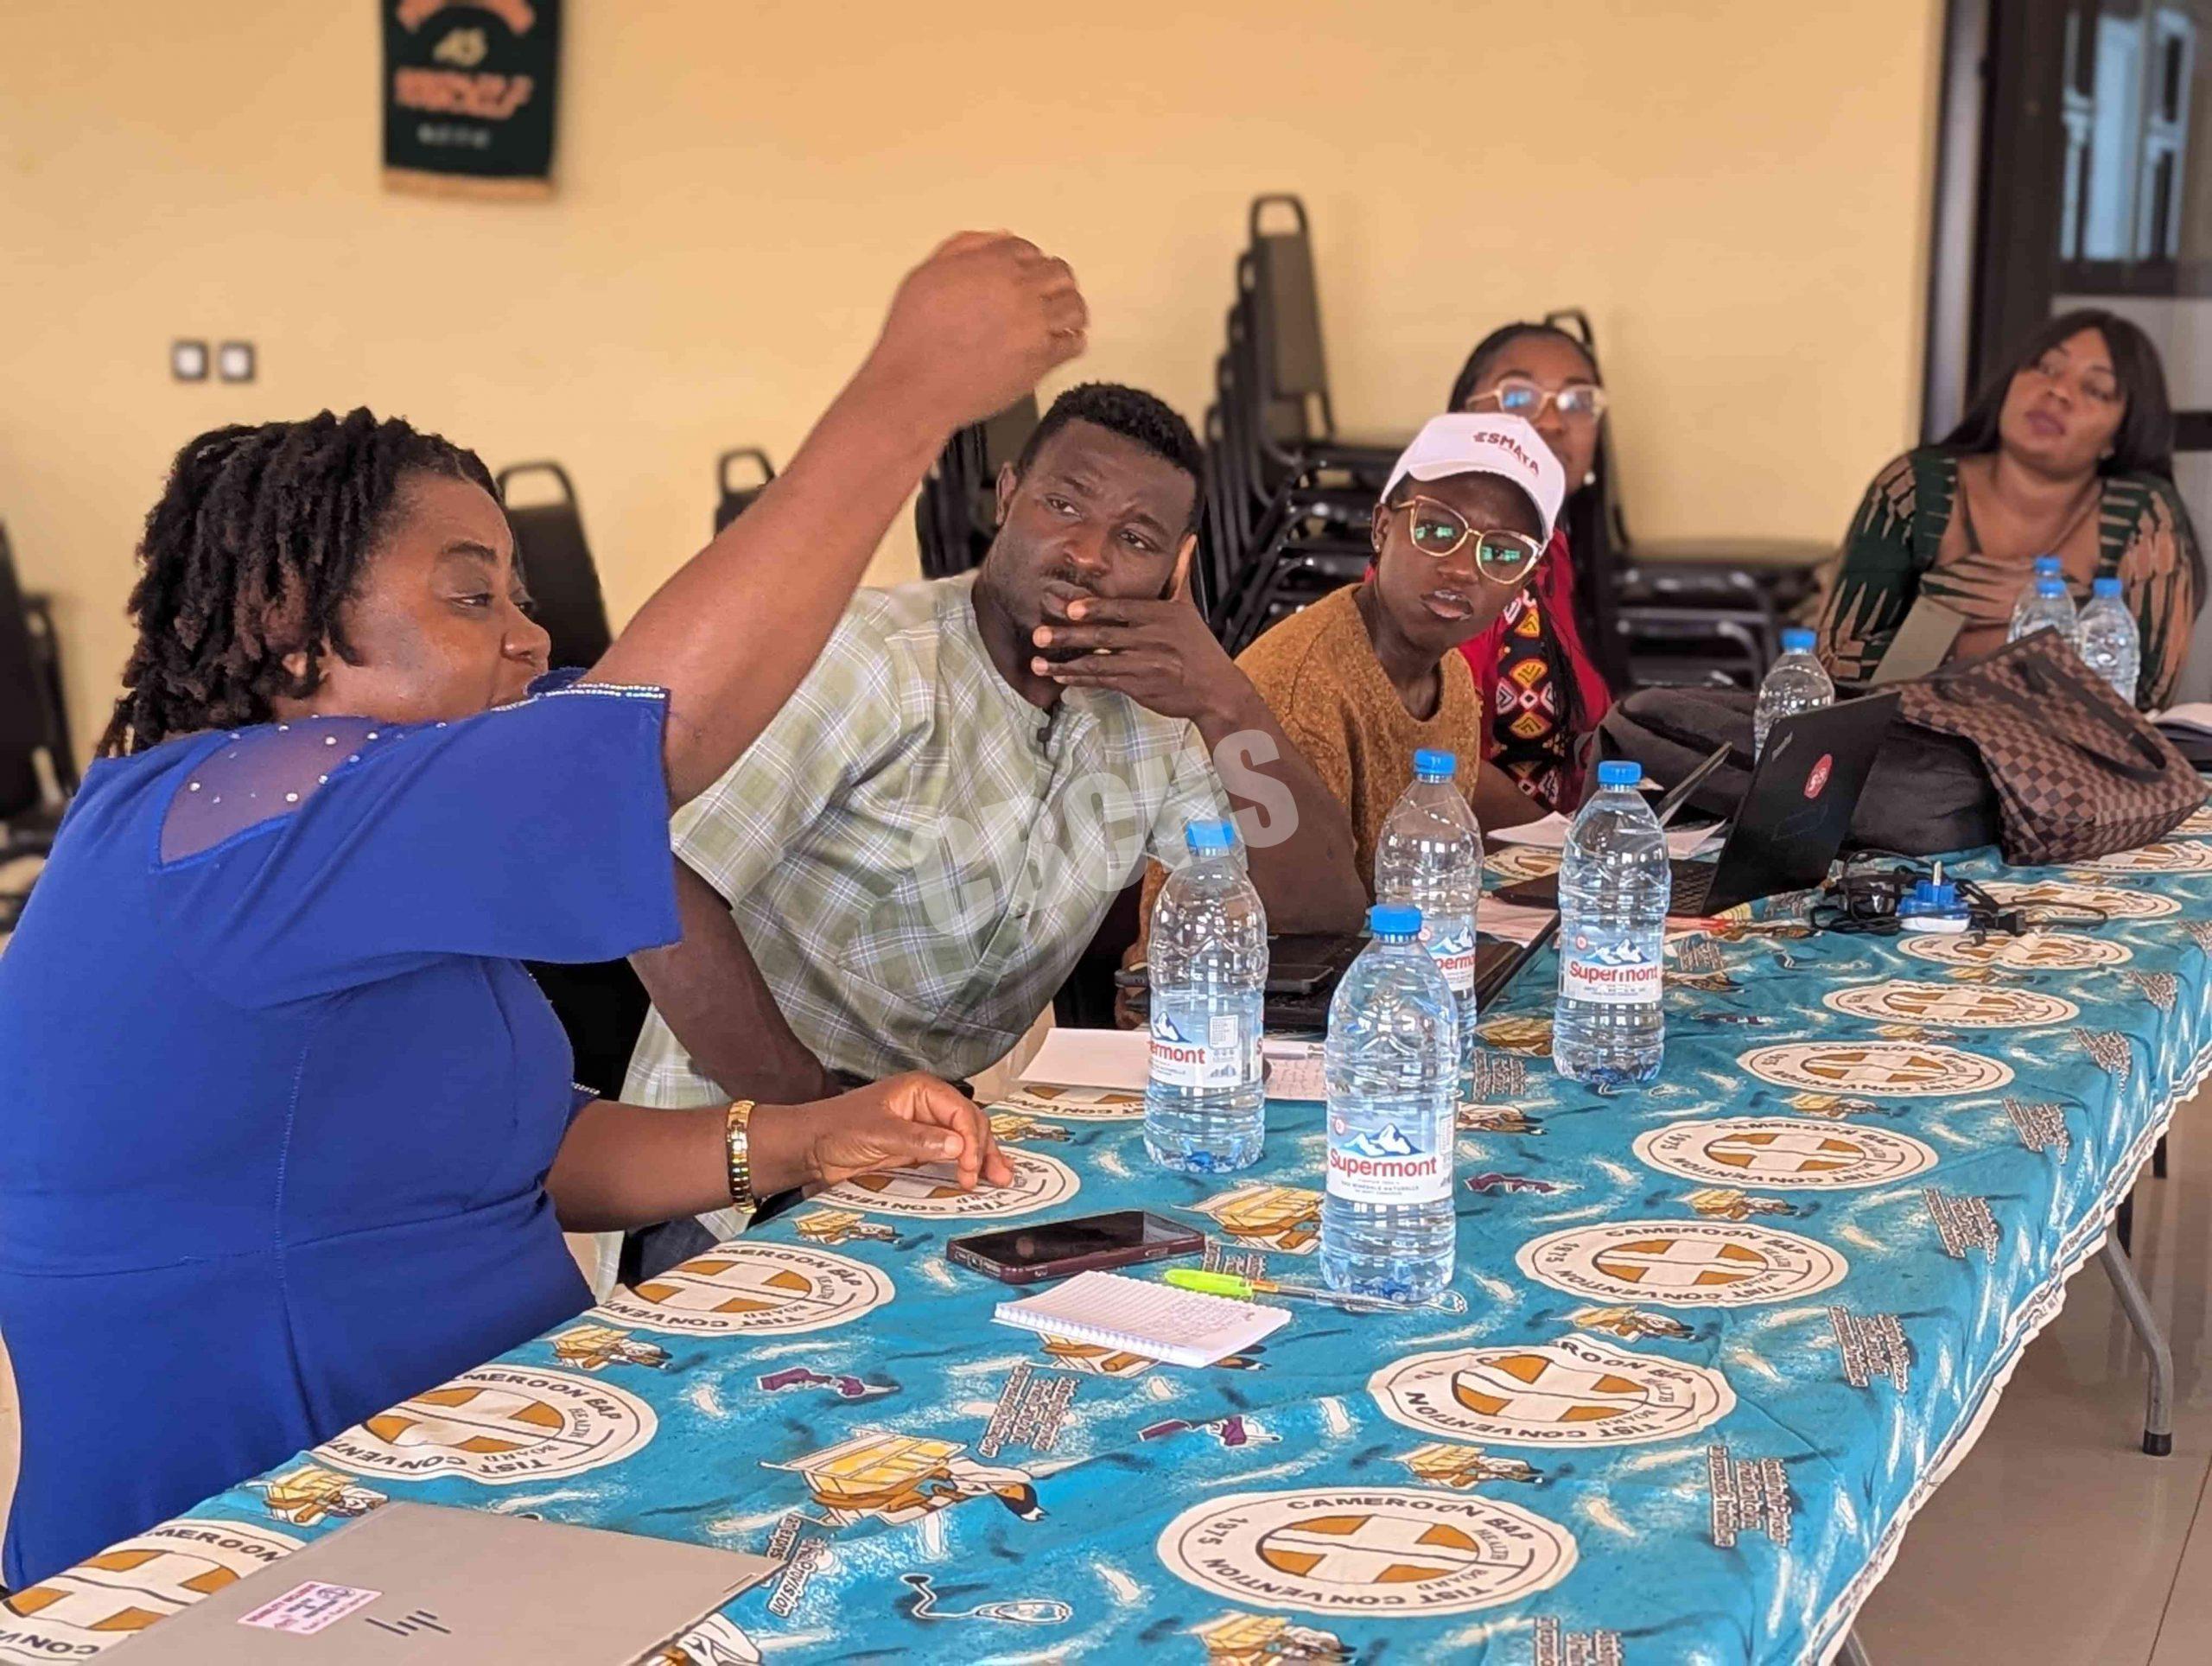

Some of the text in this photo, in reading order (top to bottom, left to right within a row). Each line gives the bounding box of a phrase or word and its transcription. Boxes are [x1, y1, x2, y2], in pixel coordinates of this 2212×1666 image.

[1569, 961, 1658, 983] Supermont
[1331, 1148, 1437, 1177] Supermont
[716, 1249, 832, 1269] MEROON
[463, 1373, 622, 1420] MEROON BAP
[1405, 1391, 1587, 1438] CONVENTION
[478, 1459, 553, 1474] TIST
[1198, 1517, 1249, 1546] 1975
[1287, 1497, 1535, 1541] CAMEROON BAP
[150, 1529, 283, 1562] MEROON
[1202, 1558, 1495, 1606] TIST CONVENTION
